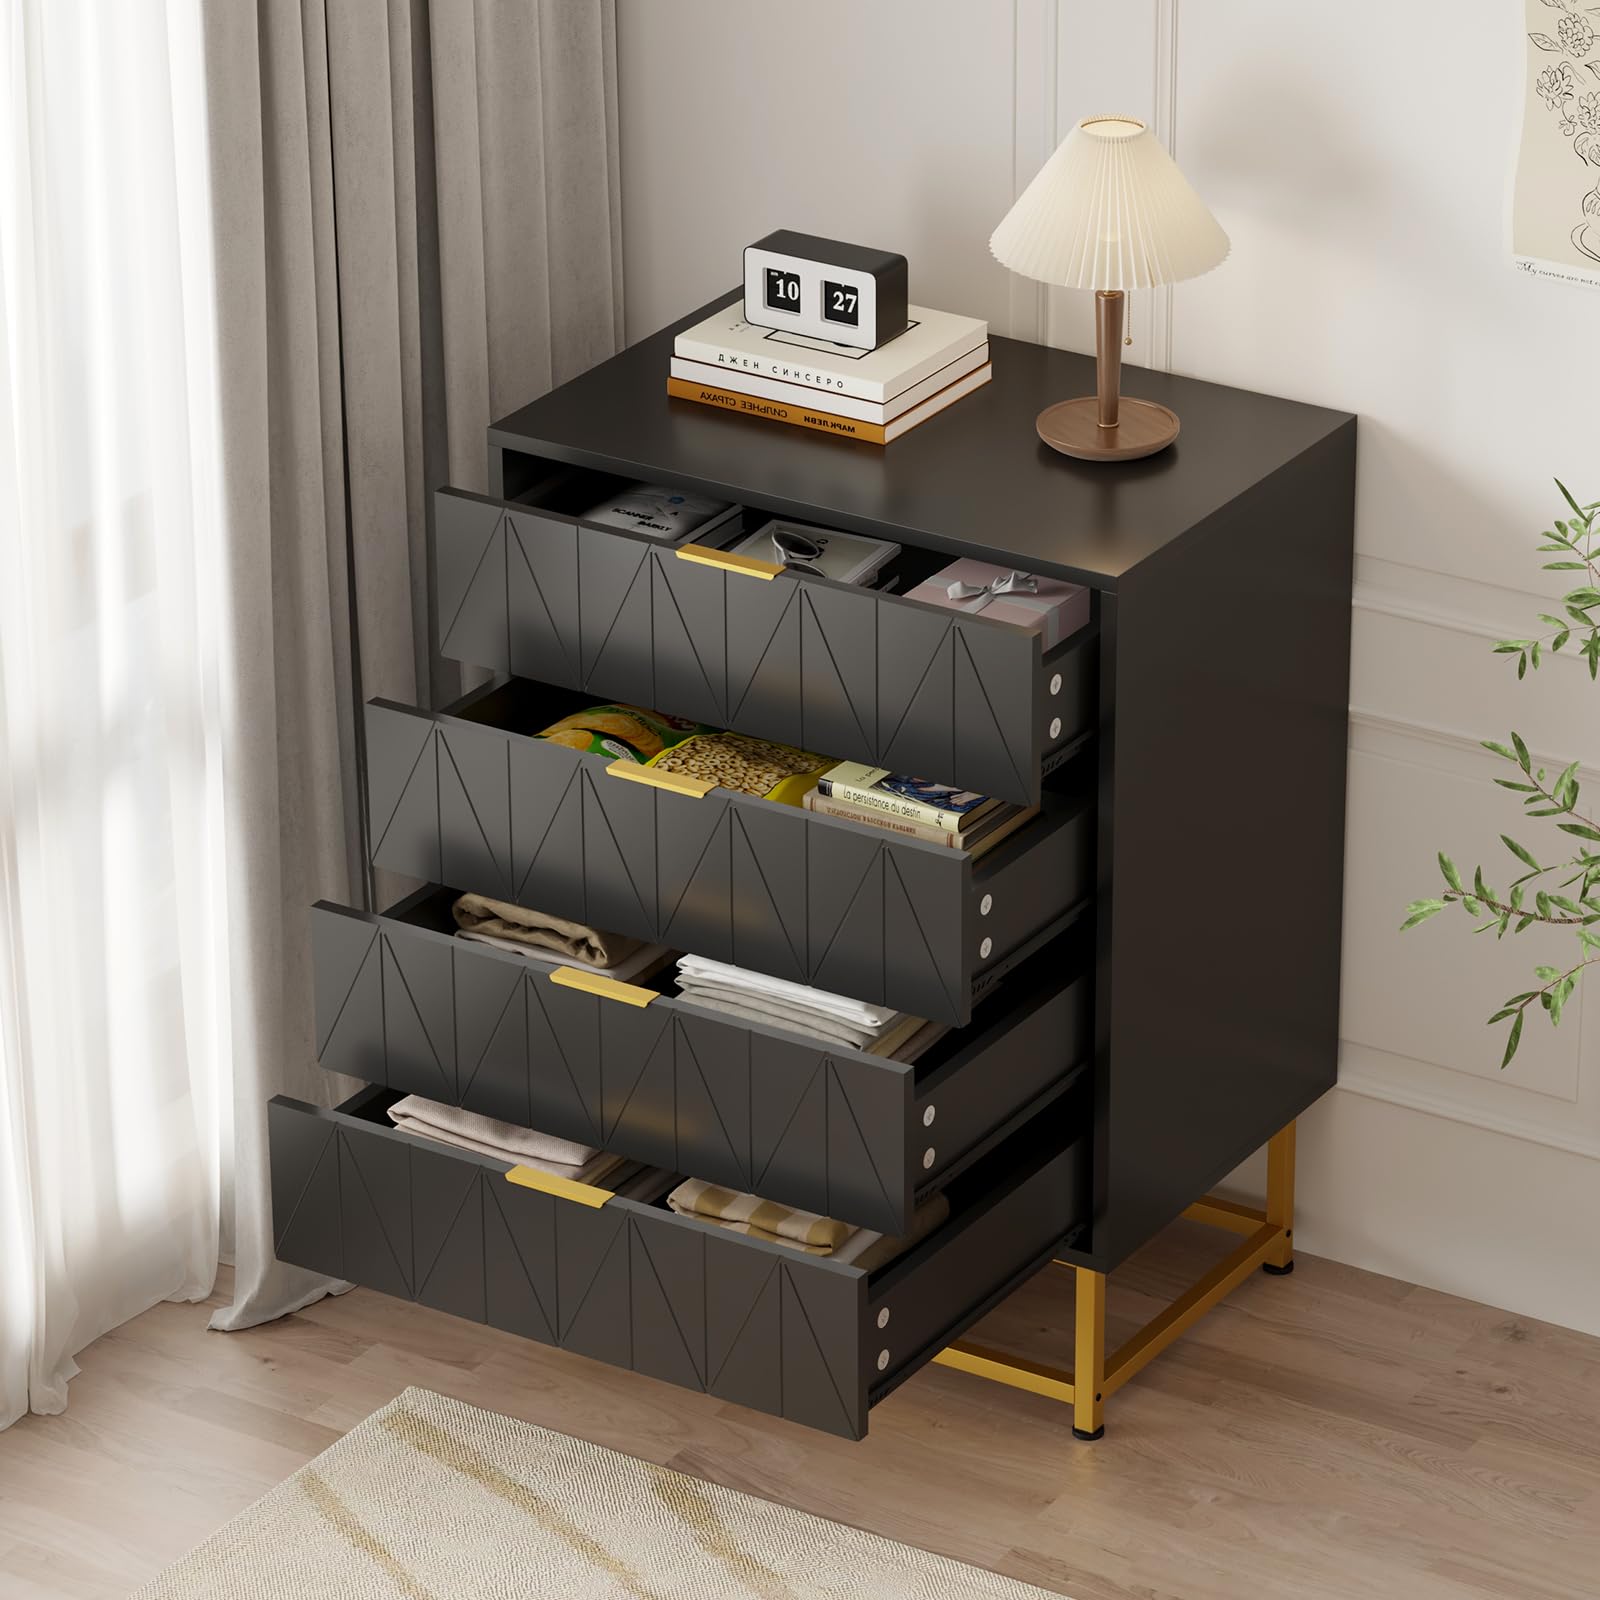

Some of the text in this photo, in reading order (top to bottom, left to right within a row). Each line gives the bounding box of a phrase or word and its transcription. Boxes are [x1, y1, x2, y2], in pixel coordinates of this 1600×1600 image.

[776, 278, 857, 313] 10 27
[718, 353, 844, 389] ДЖЕН СИНСЕРО
[853, 793, 889, 811] persistance
